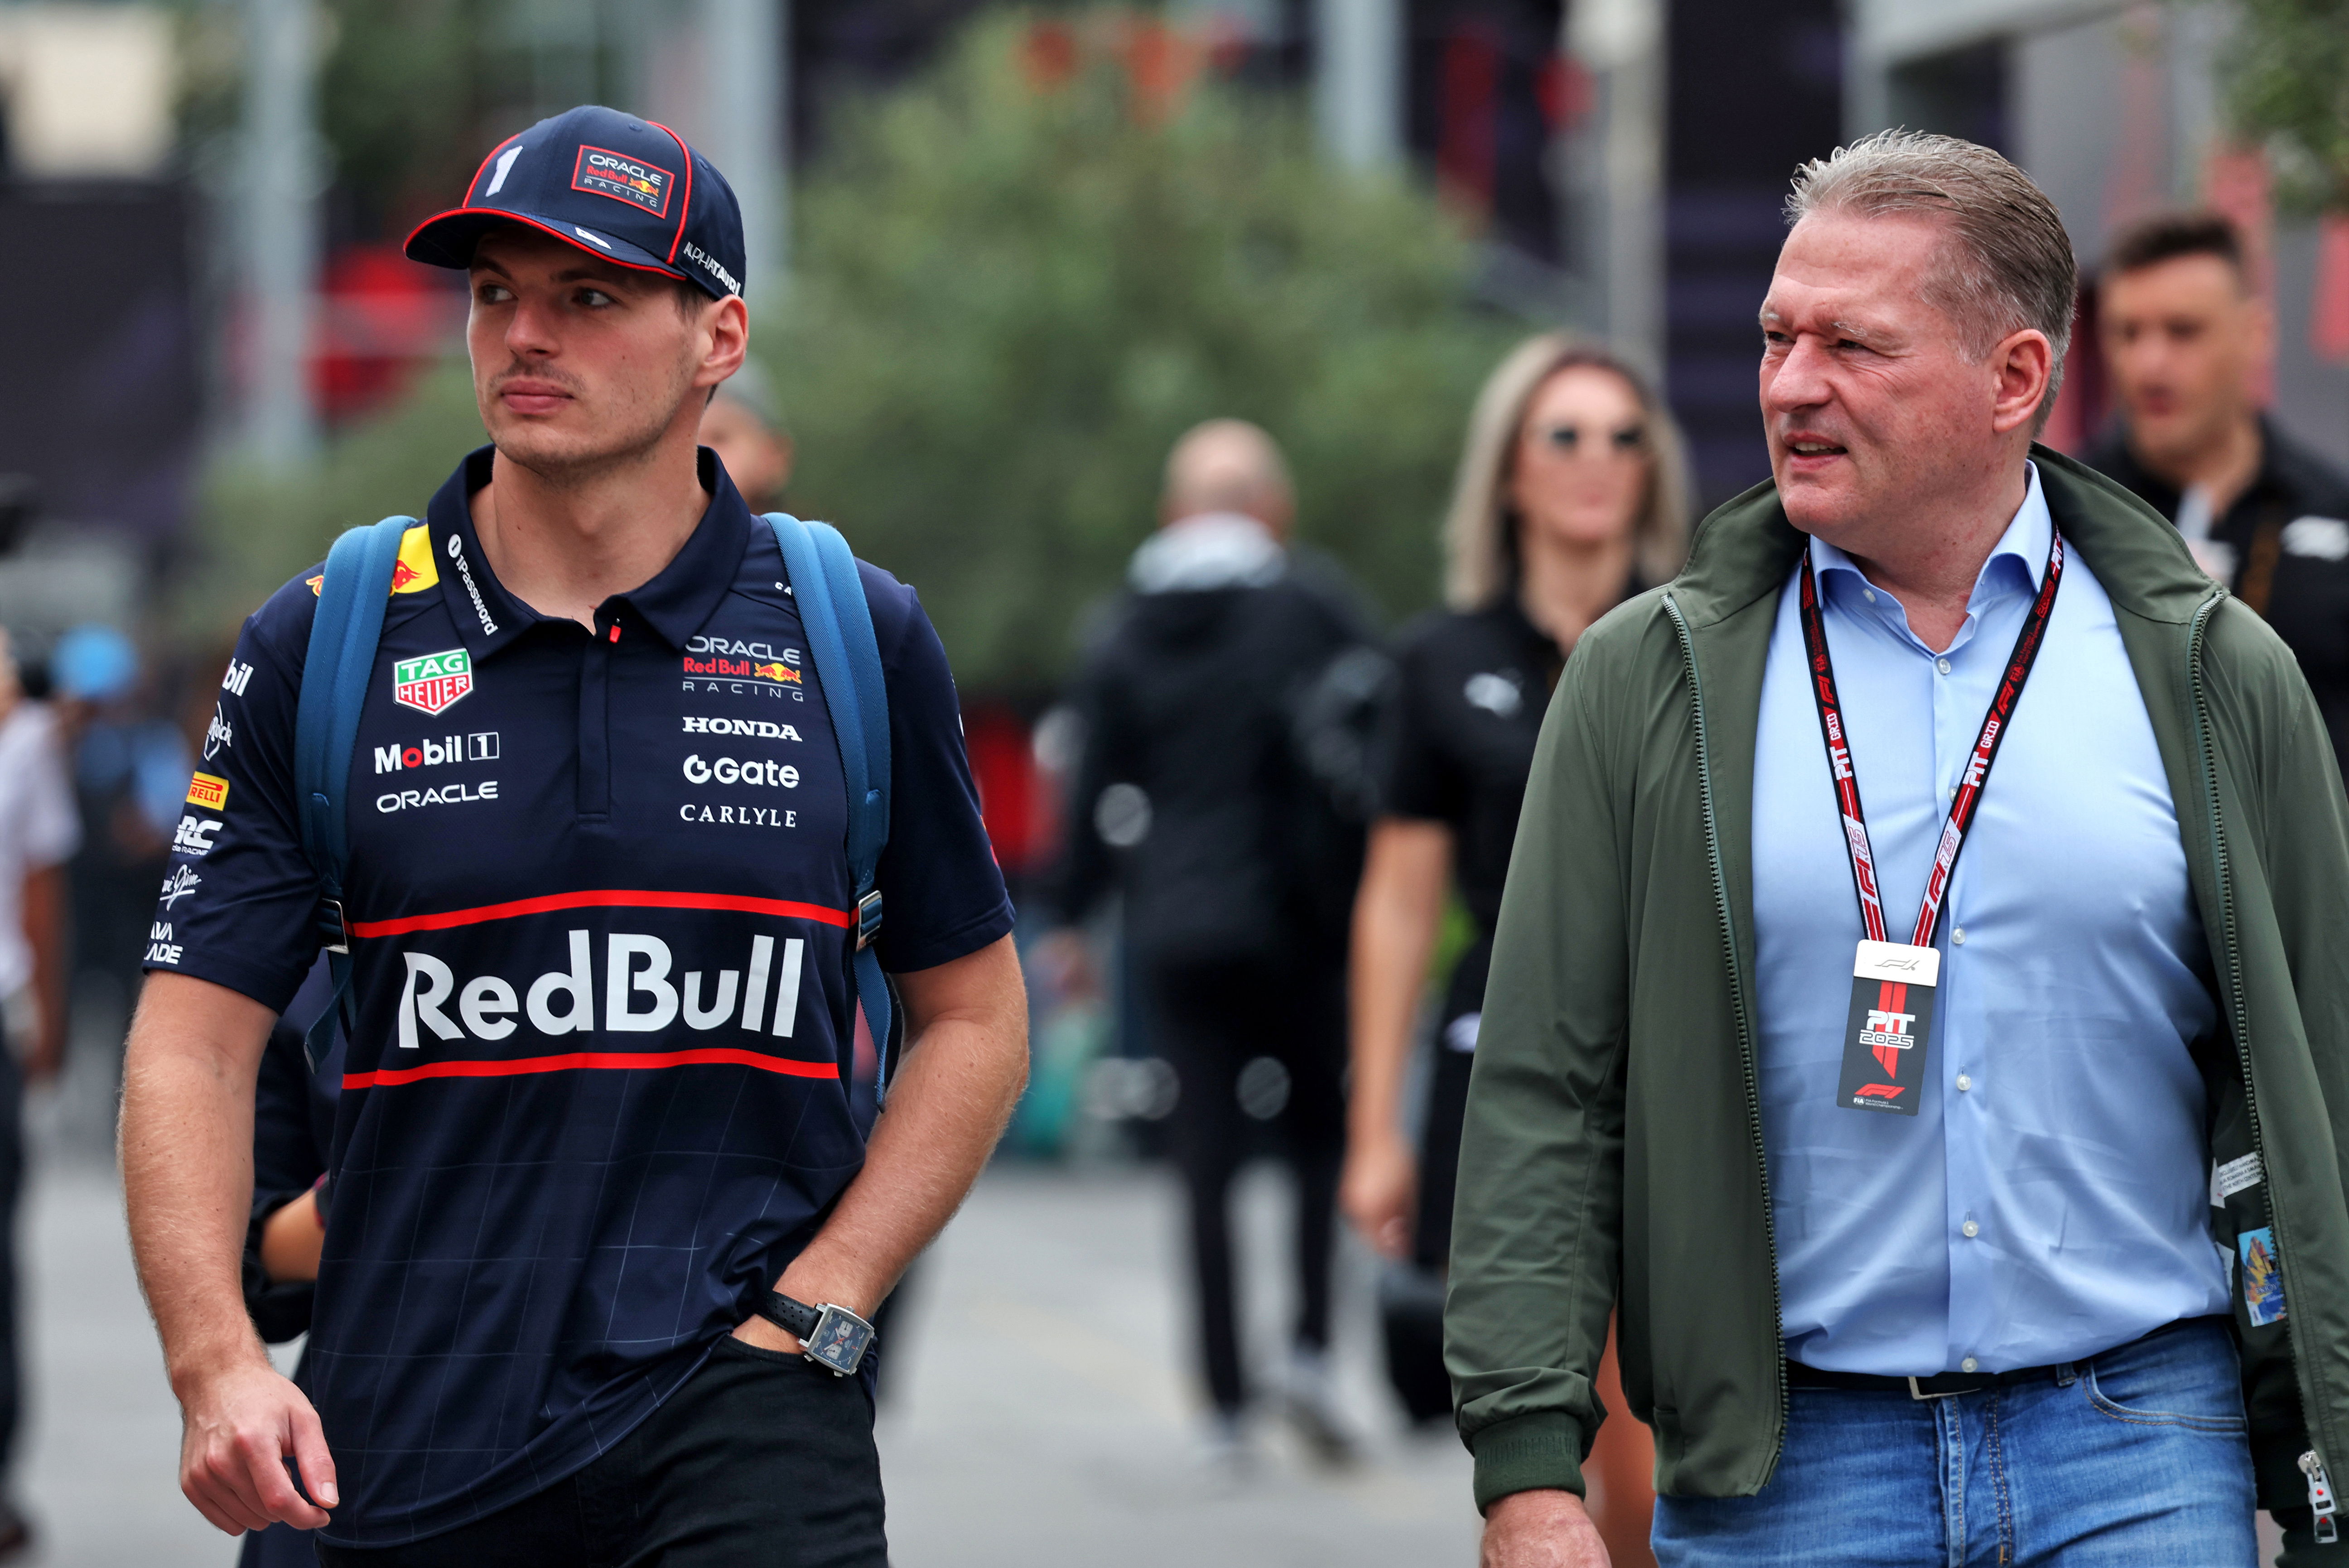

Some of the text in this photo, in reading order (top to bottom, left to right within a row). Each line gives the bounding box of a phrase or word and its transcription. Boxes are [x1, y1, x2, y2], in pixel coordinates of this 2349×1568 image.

[485, 145, 523, 197] 1
[586, 165, 628, 184] Red Bull
[589, 154, 663, 186] ORACLE
[584, 177, 658, 207] RACING
[683, 241, 741, 296] ALPHATAURI
[456, 554, 498, 636] 1Password
[685, 636, 801, 665] ORACLE
[222, 657, 254, 697] bil
[400, 653, 463, 681] TAG
[683, 657, 750, 676] Red Bull
[400, 677, 468, 710] HEUER
[682, 681, 804, 702] RACING
[682, 716, 803, 742] HONDA
[374, 735, 488, 774] Mobil 1
[1826, 712, 1853, 781] PIT GRID
[1963, 720, 2000, 787] PIT GRID
[714, 757, 800, 789] Gate
[189, 786, 221, 804] RELLI
[376, 781, 499, 814] ORACLE
[680, 804, 797, 828] CARLYLE
[144, 943, 183, 965] ADE
[1866, 1009, 1915, 1034] PIT
[1859, 1029, 1915, 1050] 2025
[1854, 1083, 1905, 1099] F1
